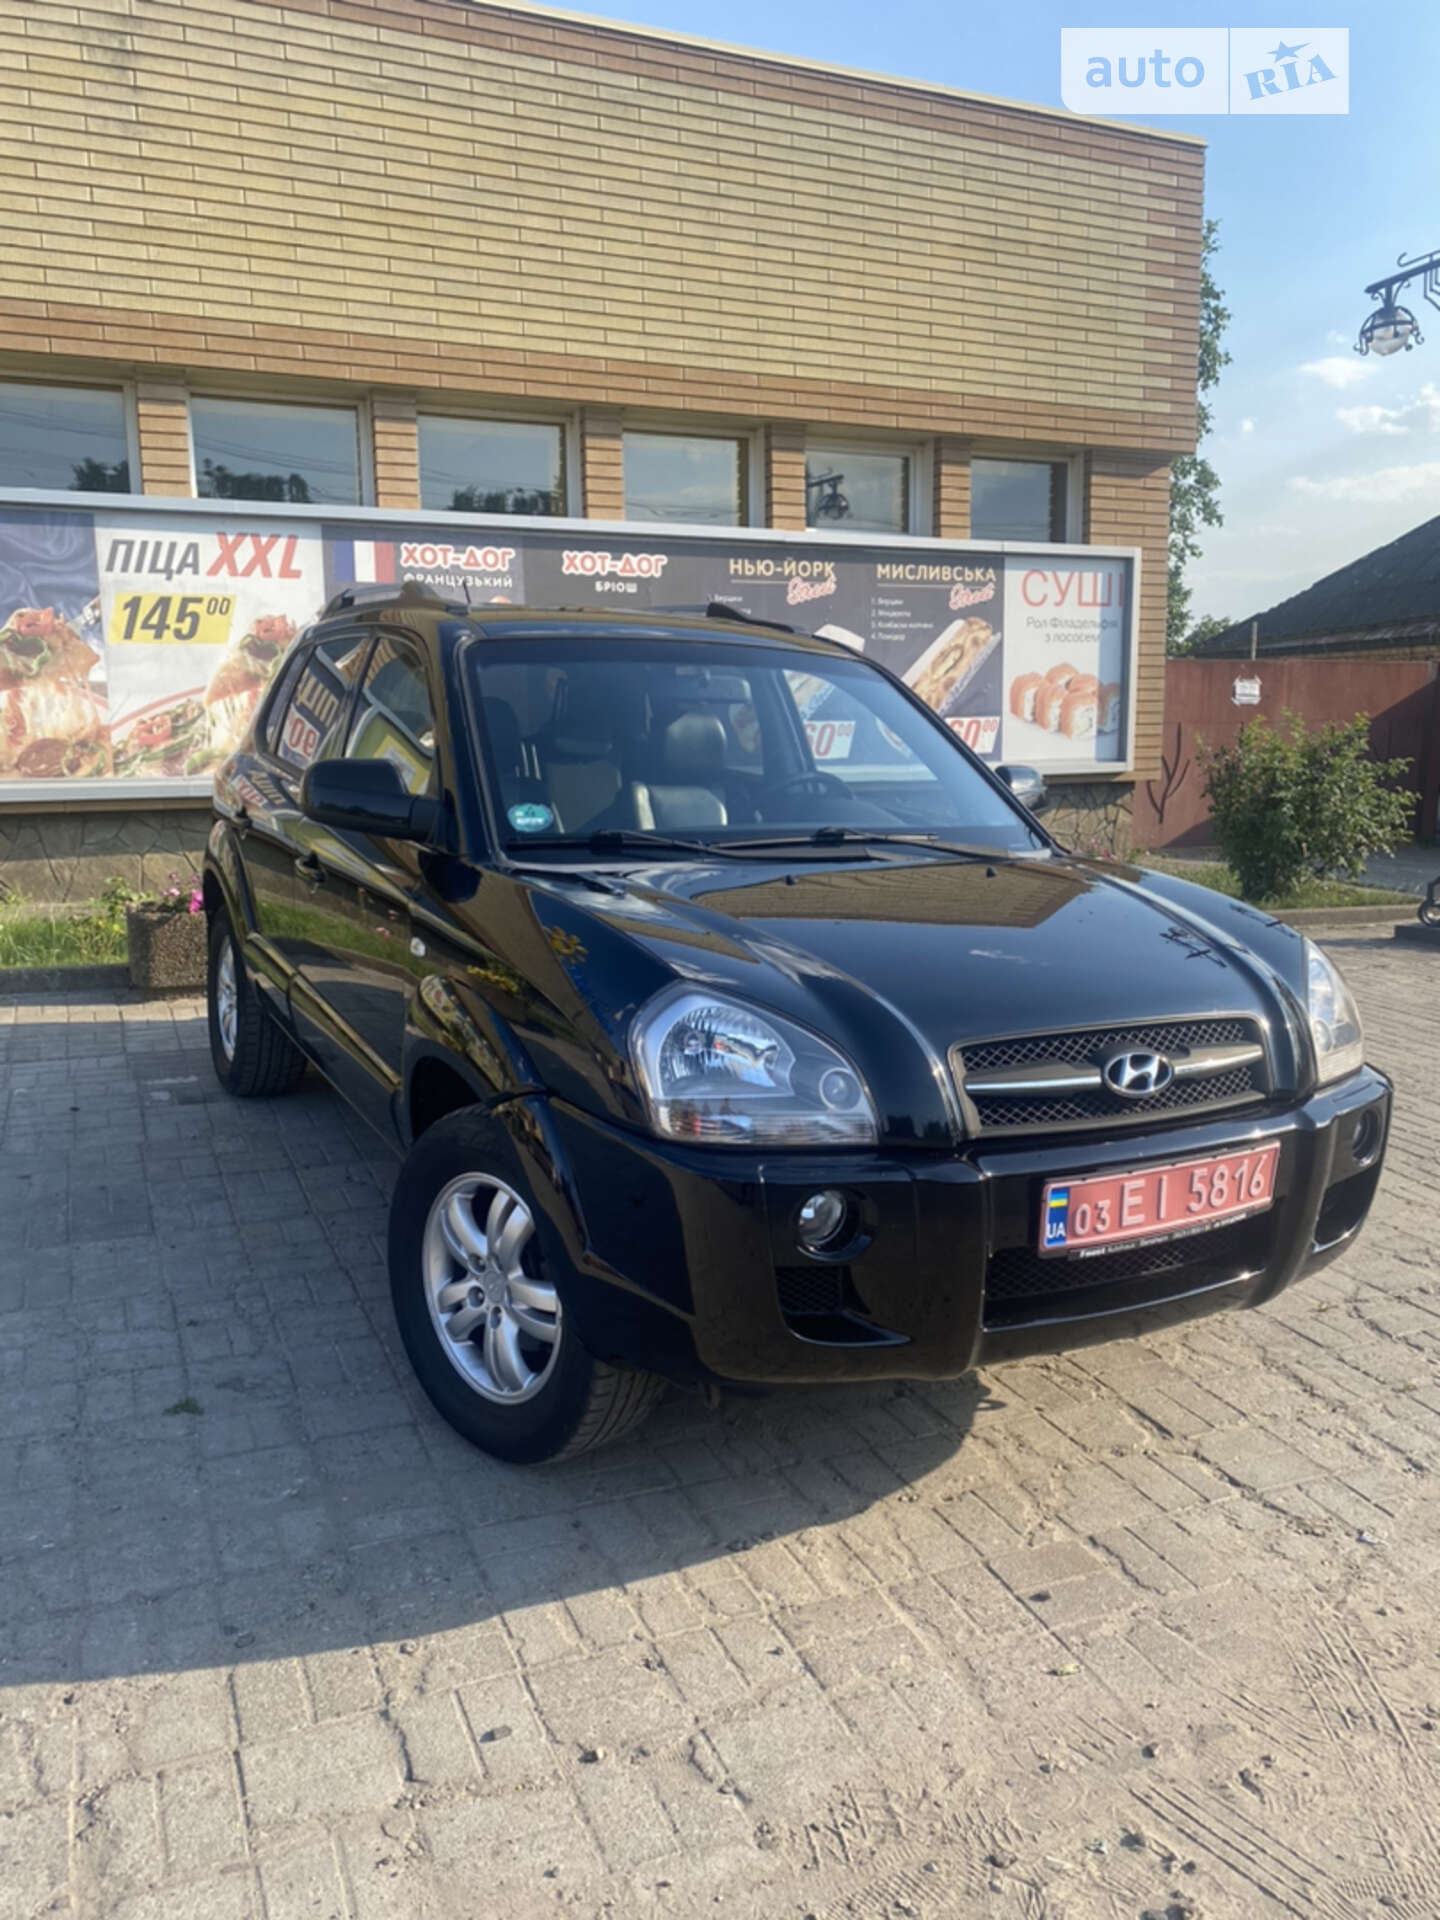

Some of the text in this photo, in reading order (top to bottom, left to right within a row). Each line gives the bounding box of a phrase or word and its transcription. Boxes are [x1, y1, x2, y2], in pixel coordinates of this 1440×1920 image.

[105, 532, 302, 581] ПІЦА XXL
[400, 543, 515, 571] ХОТ-ДОГ
[562, 550, 667, 577] ХОТ-ДОГ
[729, 557, 836, 578] НЬЮ-ЙОРК
[876, 563, 996, 582] МИСЛИВСЬКА
[595, 581, 637, 593] БРІОШ
[1021, 568, 1125, 607] СУШІ
[122, 596, 203, 641] 145
[1047, 1222, 1066, 1239] UA
[1188, 1153, 1269, 1213] 5816
